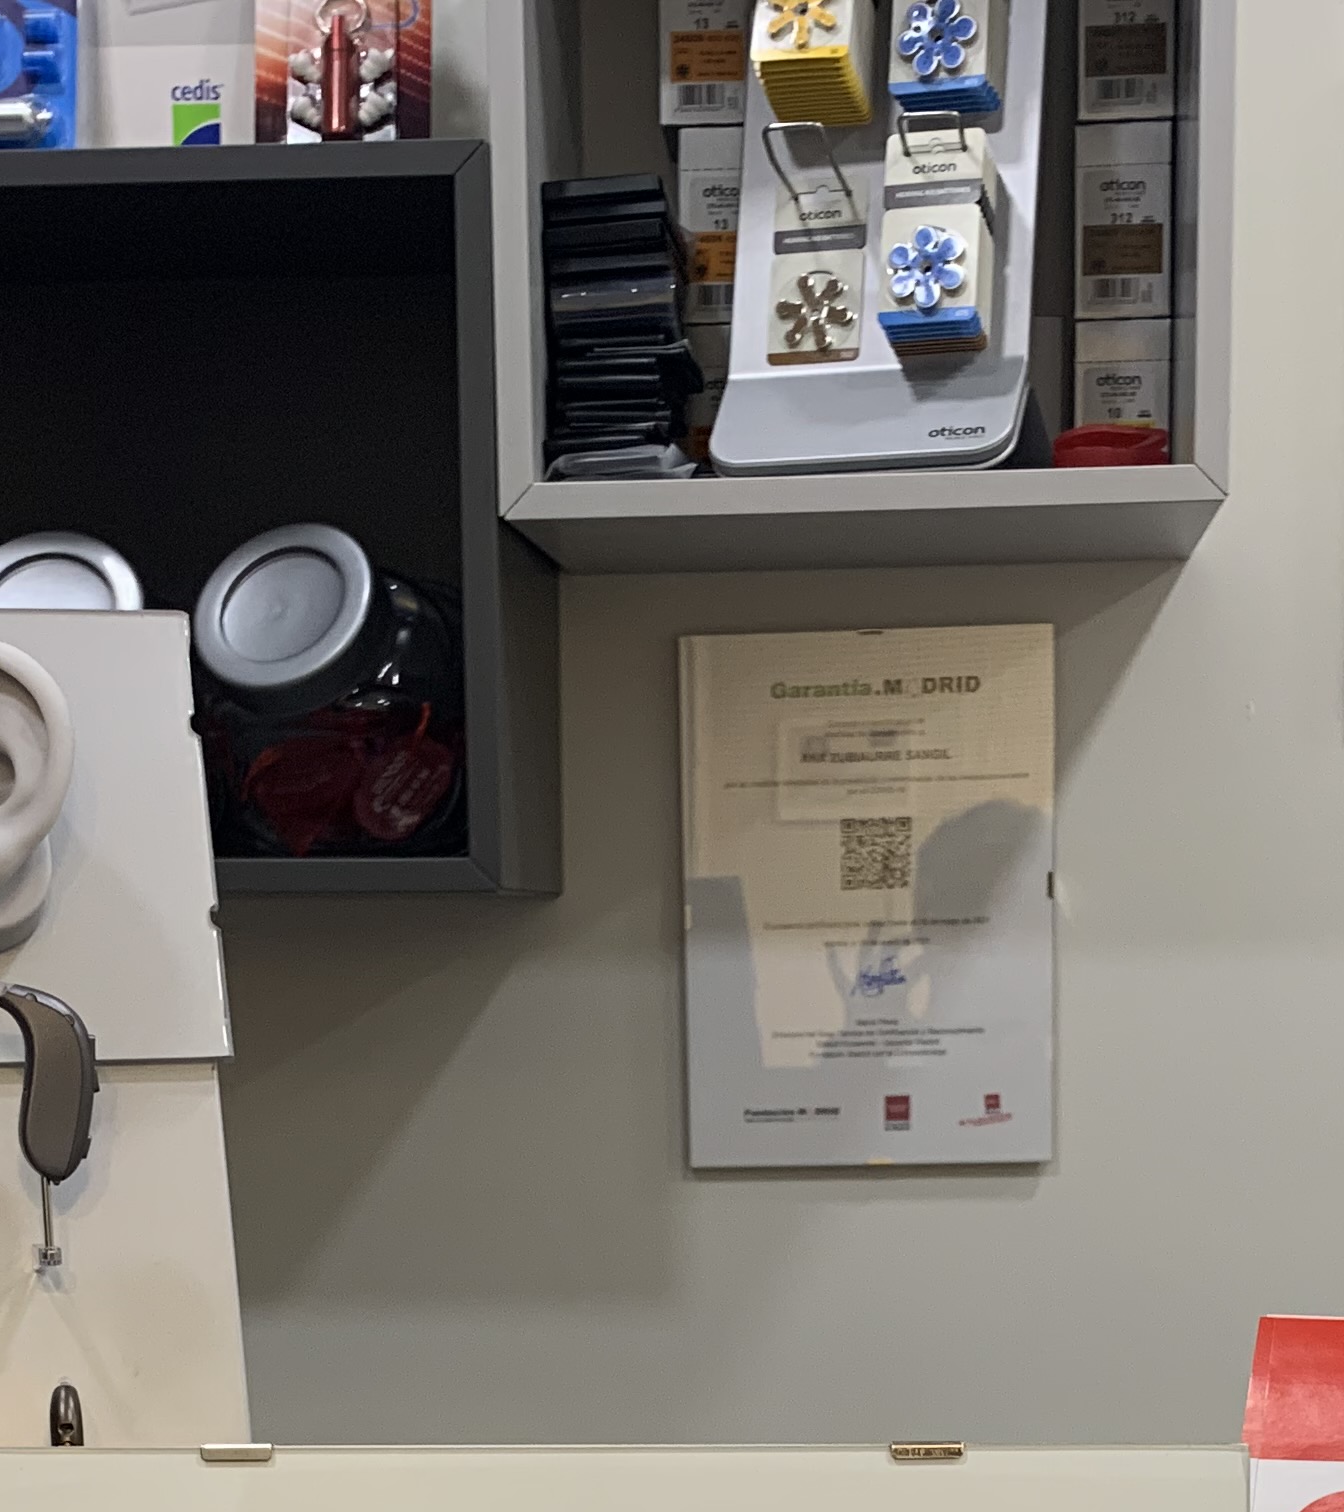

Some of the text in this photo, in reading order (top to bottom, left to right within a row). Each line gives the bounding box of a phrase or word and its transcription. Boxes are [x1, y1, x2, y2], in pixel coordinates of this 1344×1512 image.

[171, 79, 220, 101] cedis
[912, 160, 956, 175] oticon
[1100, 179, 1146, 192] oticon
[799, 208, 843, 221] oticon
[1110, 213, 1133, 223] 312
[1096, 375, 1142, 387] oticon
[928, 426, 985, 437] oticon
